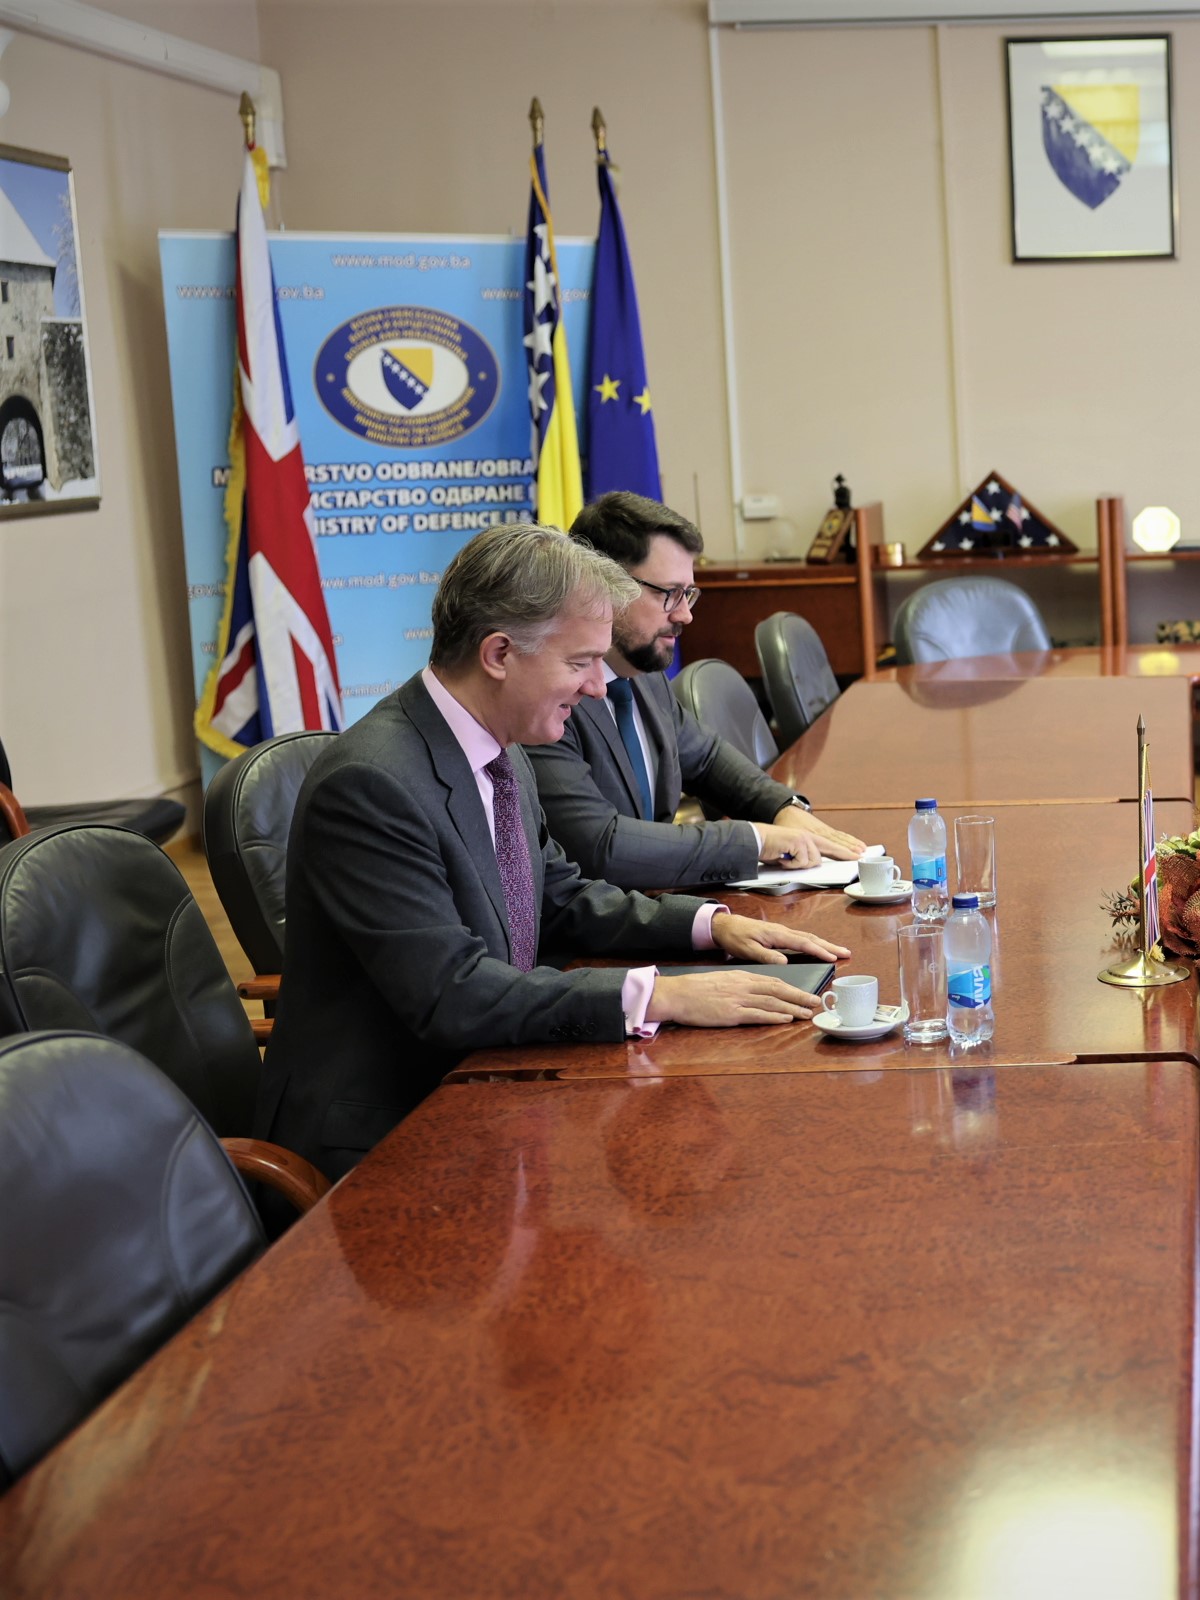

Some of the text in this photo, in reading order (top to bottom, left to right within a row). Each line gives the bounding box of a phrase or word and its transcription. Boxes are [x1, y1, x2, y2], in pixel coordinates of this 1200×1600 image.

[331, 253, 471, 271] www.mod.gov.ba
[376, 459, 535, 480] ODBRANE/OBRA
[430, 485, 525, 507] ОДБРАНЕ
[381, 515, 410, 533] OF
[413, 511, 501, 532] DEFENCE
[321, 571, 440, 588] ww.mod.gov.ba
